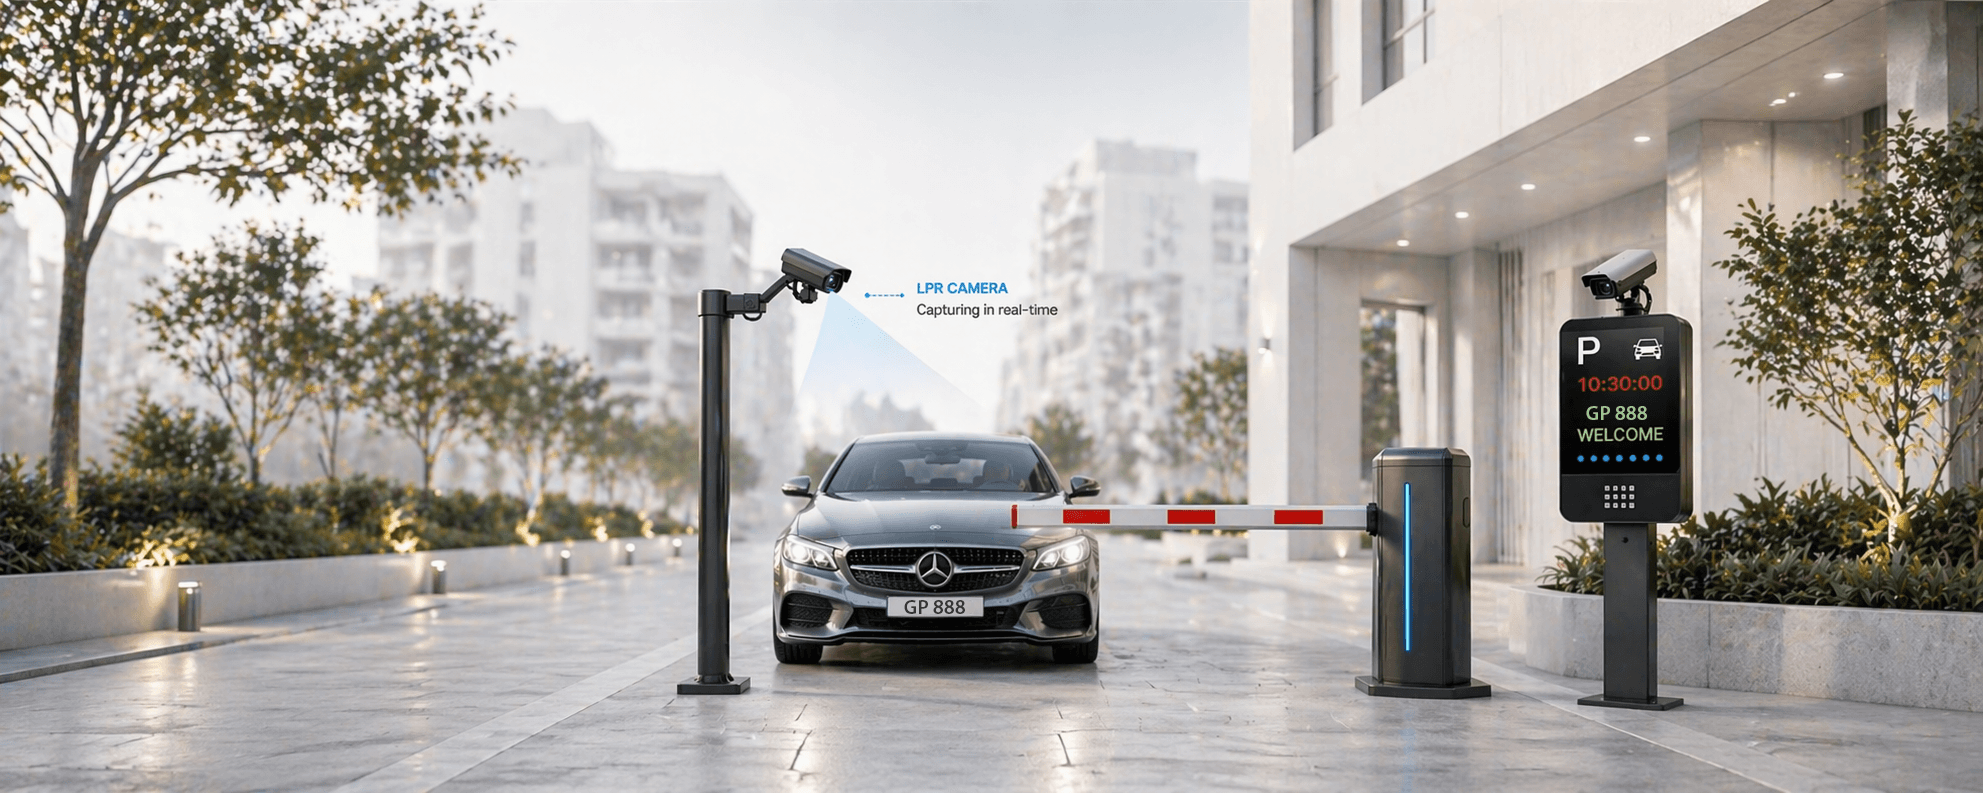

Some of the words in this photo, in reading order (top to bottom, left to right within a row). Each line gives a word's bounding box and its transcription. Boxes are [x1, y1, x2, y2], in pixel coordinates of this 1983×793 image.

[1577, 336, 1601, 365] P
[1578, 375, 1663, 393] 10:30:00
[1586, 405, 1611, 421] GP
[1615, 405, 1648, 421] 888
[1577, 427, 1664, 443] WELCOME
[904, 600, 929, 615] GP
[933, 600, 966, 615] 888
